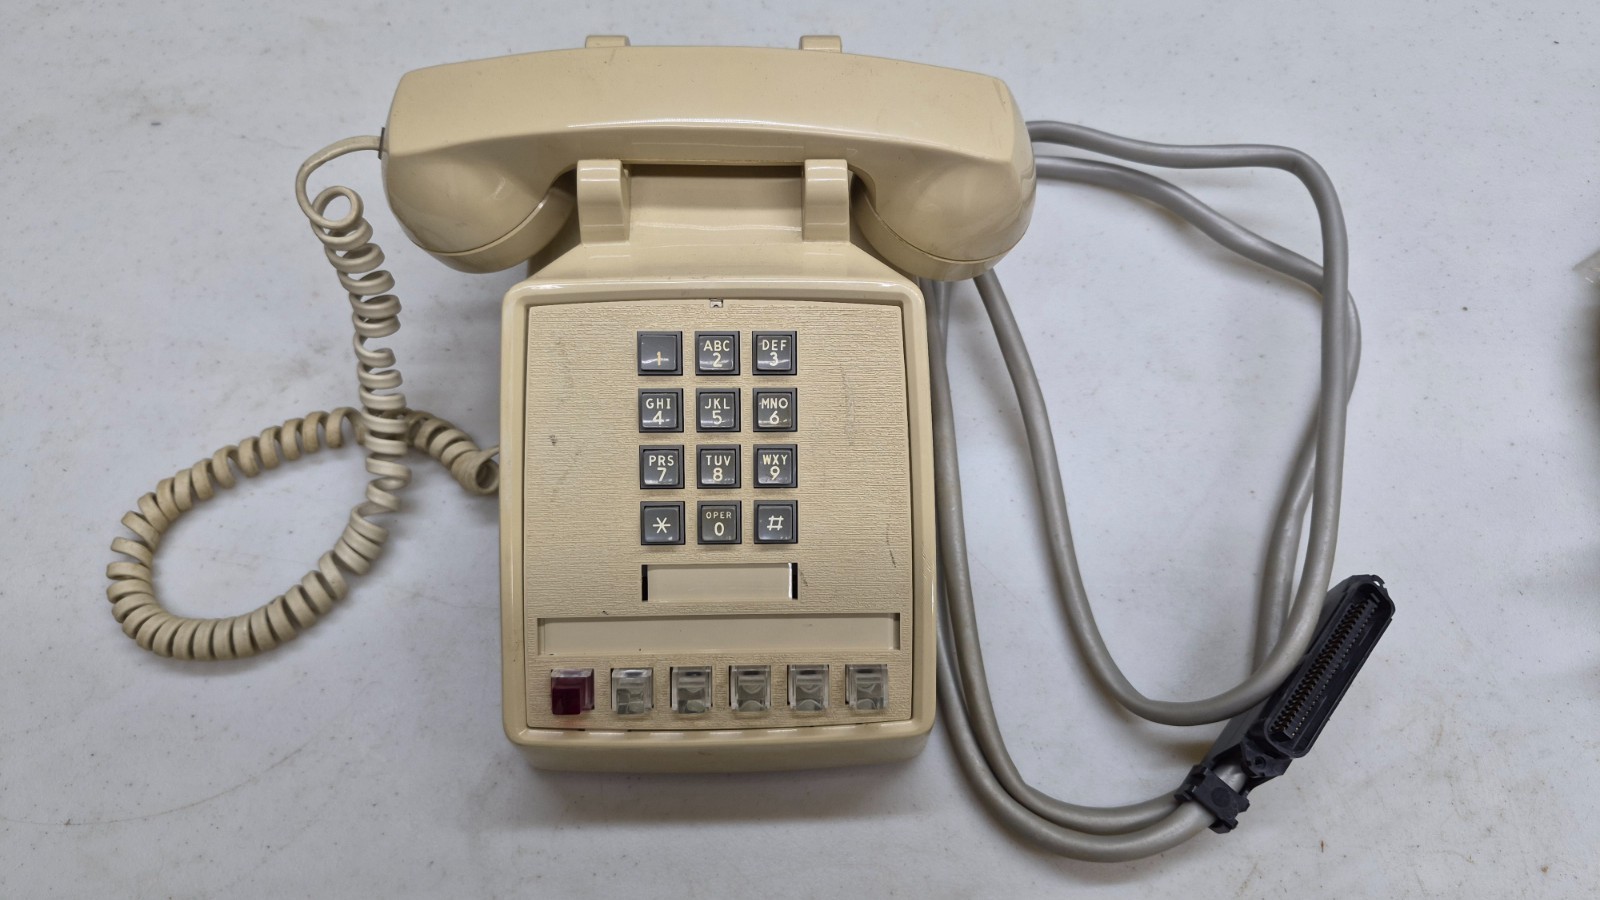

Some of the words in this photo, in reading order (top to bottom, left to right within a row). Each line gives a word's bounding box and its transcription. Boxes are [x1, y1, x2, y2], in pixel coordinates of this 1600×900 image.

[703, 340, 730, 352] ABC
[762, 339, 787, 351] DEF
[712, 352, 723, 367] 2
[769, 352, 779, 367] 3
[646, 398, 671, 409] GHI
[704, 398, 731, 409] JKL
[761, 398, 788, 409] MNO
[652, 411, 663, 425] 4
[712, 411, 722, 425] 5
[769, 410, 780, 425] 6
[649, 455, 674, 466] PRS
[706, 455, 731, 466] TUV
[763, 454, 788, 465] WXY
[657, 467, 667, 482] 7
[712, 467, 723, 482] 8
[770, 466, 780, 480] 9
[714, 522, 724, 537] 0
[766, 515, 784, 531] #
